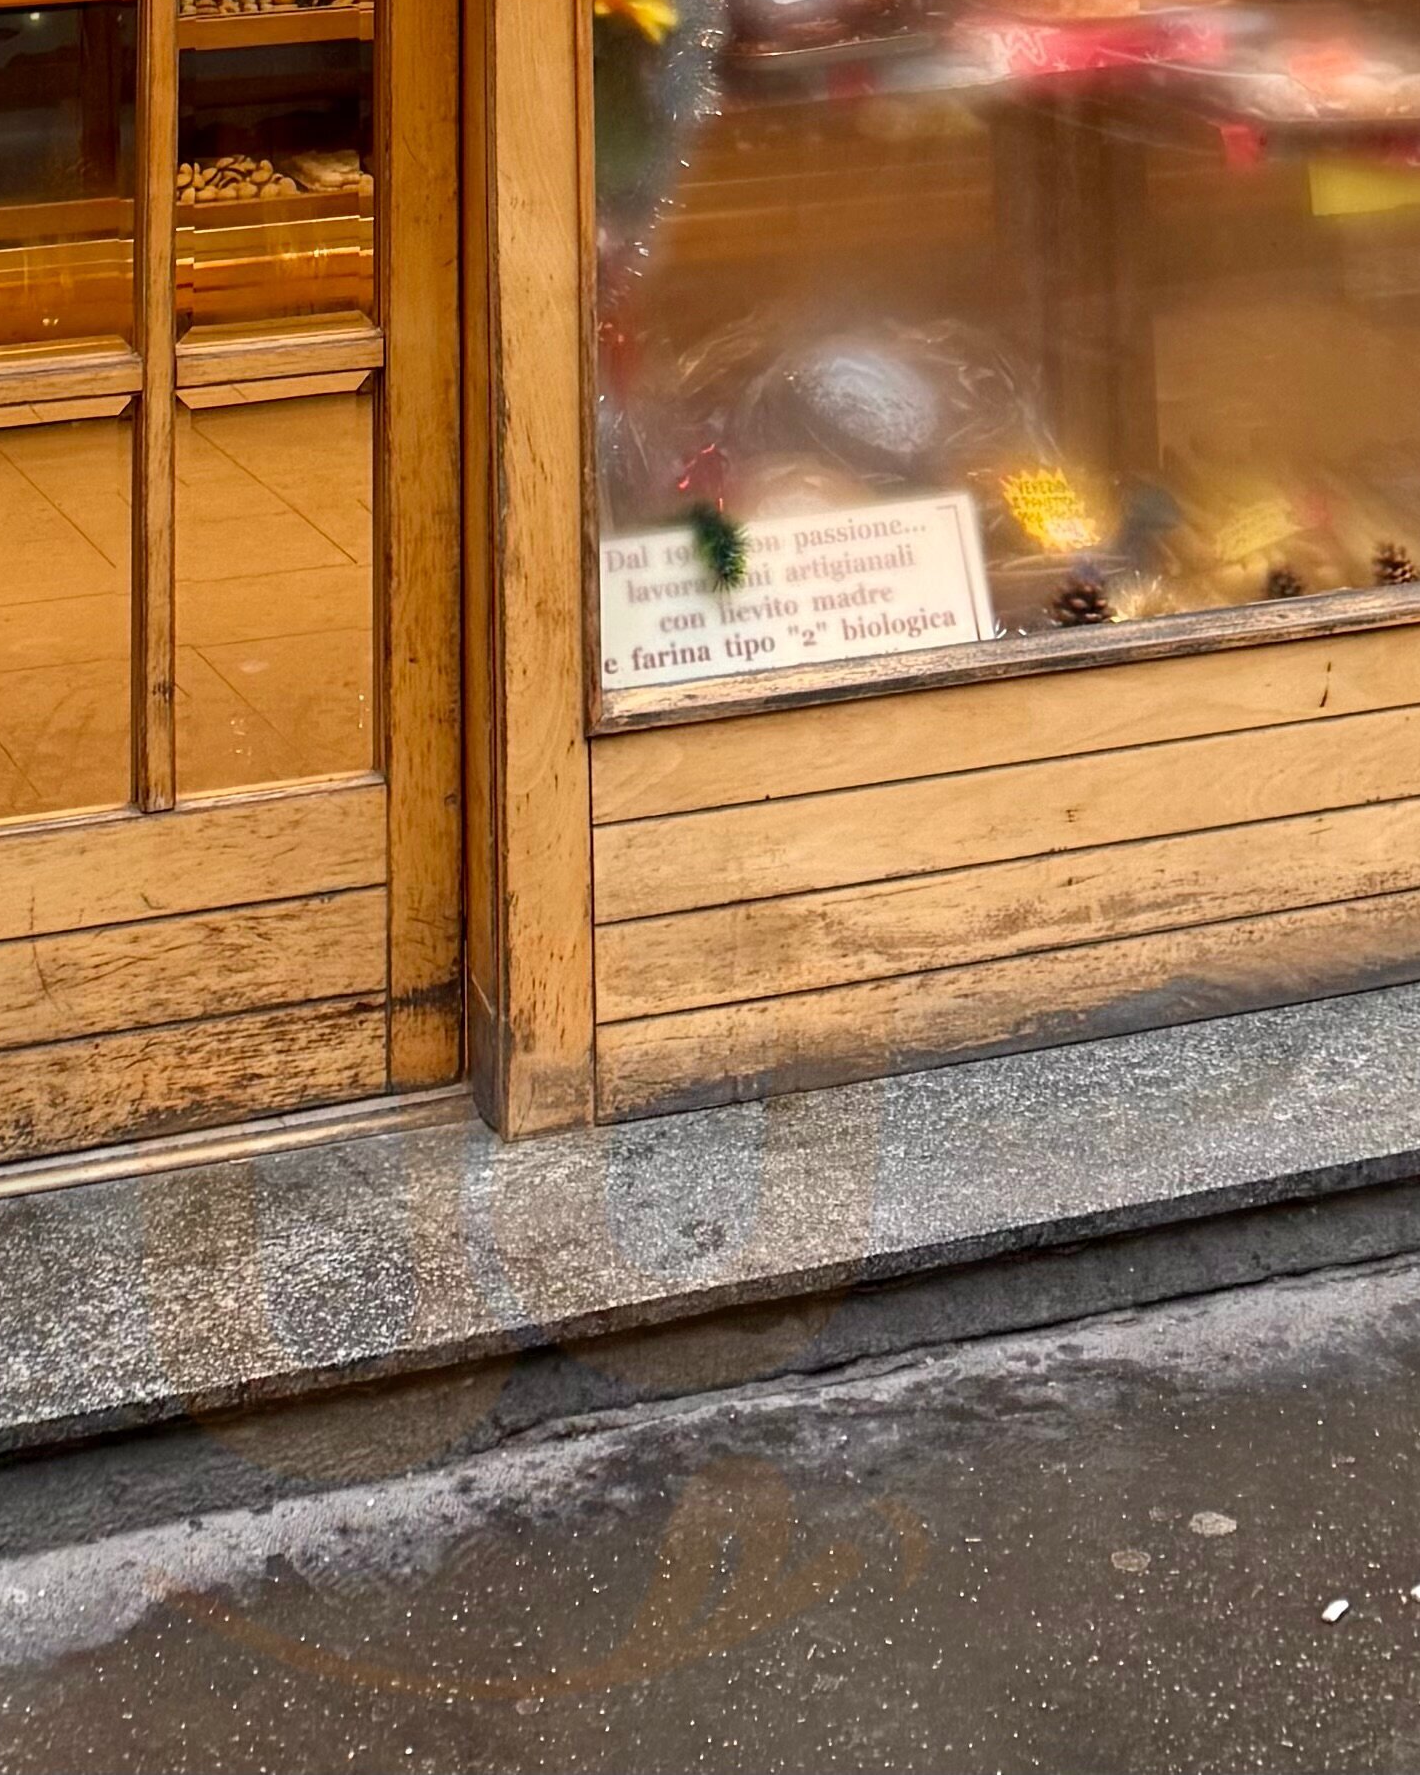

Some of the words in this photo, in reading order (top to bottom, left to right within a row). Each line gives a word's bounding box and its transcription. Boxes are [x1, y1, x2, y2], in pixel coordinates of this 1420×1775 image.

[606, 545, 648, 575] Dal
[793, 518, 927, 556] passione...
[785, 544, 916, 585] artigianali
[659, 610, 706, 635] con
[720, 593, 799, 627] lievito
[812, 581, 895, 613] madre
[603, 655, 619, 675] e
[630, 642, 713, 673] farina
[725, 631, 777, 663] tipo
[787, 621, 828, 647] "2"
[841, 606, 957, 643] biologica
